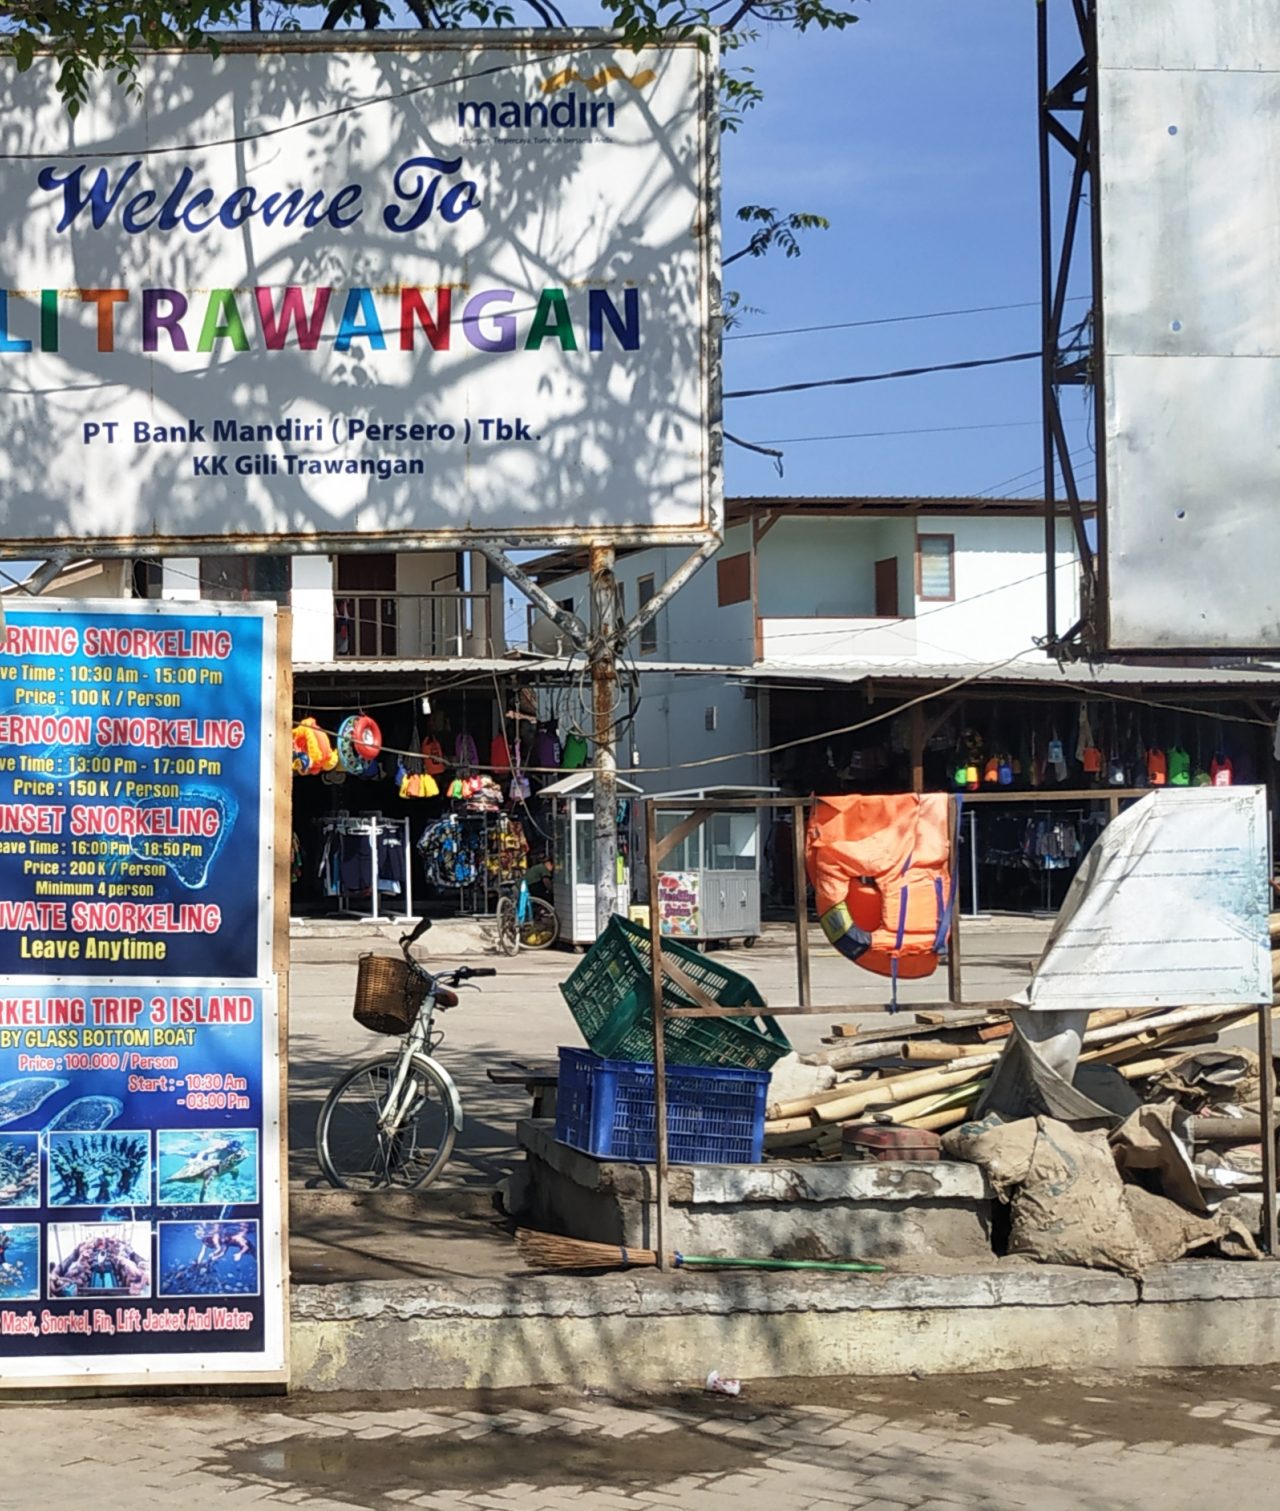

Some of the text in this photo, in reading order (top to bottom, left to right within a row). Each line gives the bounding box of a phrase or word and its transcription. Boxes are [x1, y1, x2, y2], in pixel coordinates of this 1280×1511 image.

[458, 92, 615, 128] mandiri
[37, 156, 481, 234] Welcome To
[81, 286, 639, 352] TRAWANGAN
[83, 418, 542, 444] PT Bank Mandiri Tbk.
[194, 454, 425, 480] KK Gili Trawangan
[82, 627, 232, 660] SNORKELING
[70, 665, 112, 681] 10:30
[116, 667, 138, 683] Am
[154, 668, 197, 683] 15:00
[200, 669, 223, 684] Pm
[96, 717, 244, 749] SNORKELING
[68, 757, 111, 773] 13:00
[153, 759, 196, 775] 17:00
[69, 780, 178, 799] 150 Person
[71, 804, 219, 837] SNORKELING
[71, 841, 107, 856] 16:00
[69, 861, 165, 877] 200 Person
[35, 881, 154, 899] Minimum 4 person
[71, 902, 221, 933] SNORKELING
[20, 936, 167, 962] Leave Anytime
[91, 996, 143, 1026] TRIP
[151, 997, 166, 1023] 3
[171, 996, 254, 1024] ISLAND
[0, 1027, 197, 1049] BY GLASS BOTTOM BOAT
[65, 1053, 178, 1070] 100.000 Person
[2, 1306, 253, 1337] Mask, Snorkel, Fin, Jacket Water
